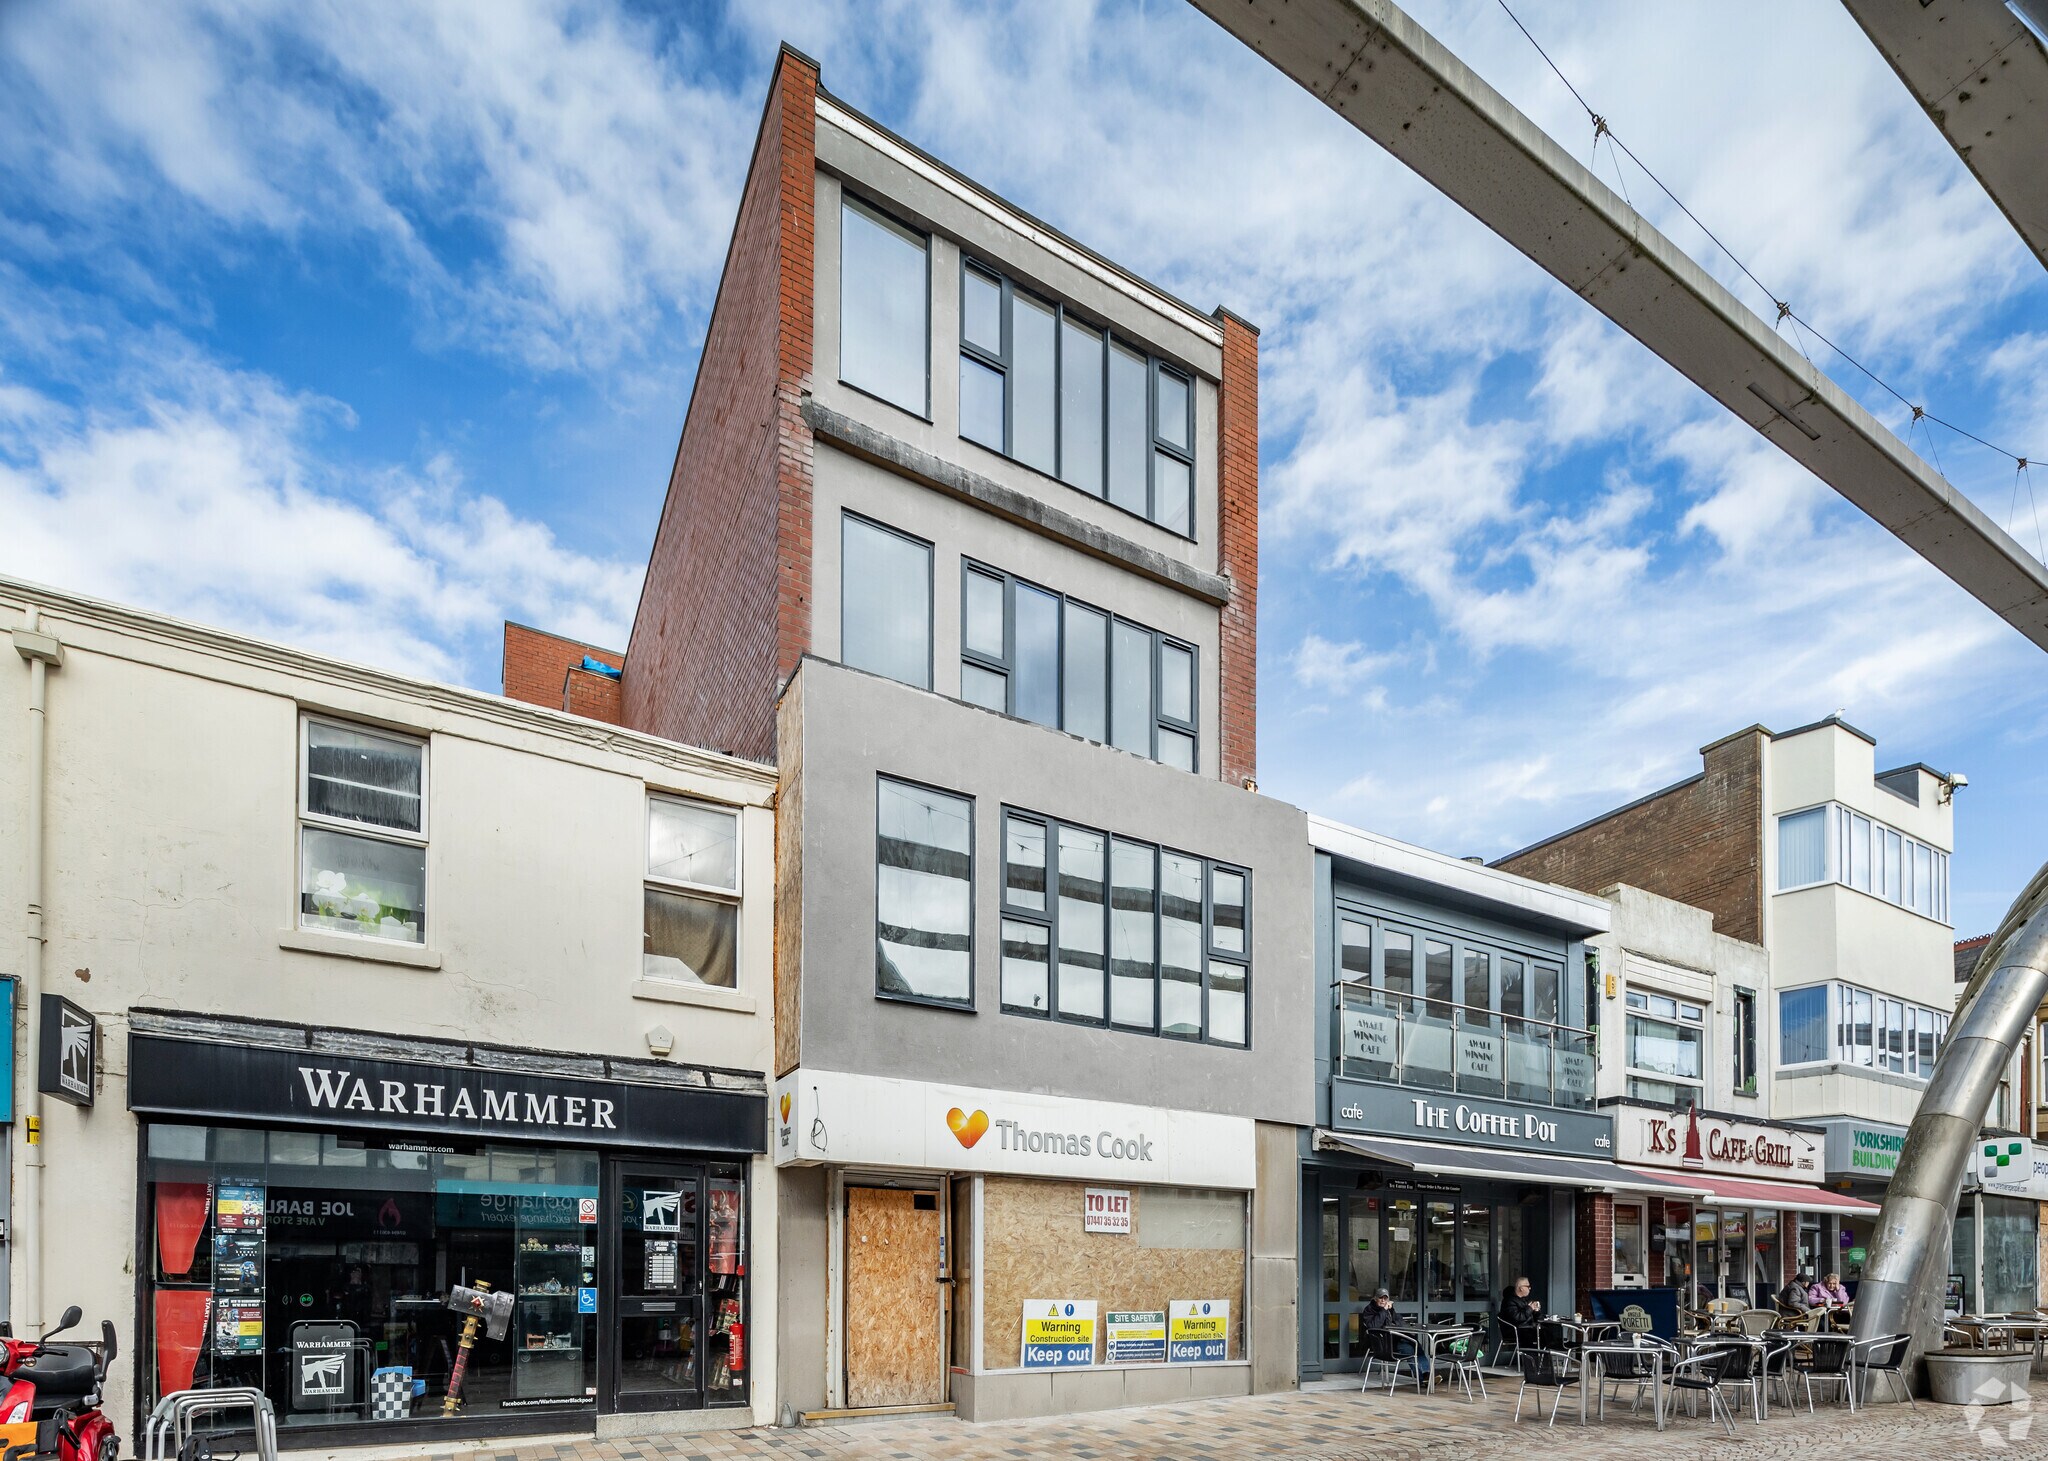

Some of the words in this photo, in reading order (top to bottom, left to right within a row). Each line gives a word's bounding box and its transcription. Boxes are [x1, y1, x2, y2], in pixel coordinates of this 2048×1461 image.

[1353, 1030, 1388, 1044] WINNING
[1361, 1044, 1382, 1055] CAFE
[1464, 1049, 1494, 1062] WINNING
[1471, 1062, 1489, 1073] CAFE
[61, 1074, 89, 1095] WARHAMMER
[298, 1067, 617, 1129] WARHAMMER
[1341, 1102, 1363, 1120] cafe
[1411, 1098, 1449, 1129] THE
[1455, 1104, 1520, 1138] COFFEE
[1524, 1113, 1558, 1142] POT
[995, 1118, 1091, 1157] Thomas
[1096, 1130, 1153, 1162] Cook
[1594, 1134, 1610, 1149] cafe
[388, 1142, 454, 1154] warhammer.com
[1706, 1127, 1747, 1162] CAFE
[1748, 1144, 1754, 1158] &
[1754, 1135, 1794, 1168] GRILL
[1087, 1194, 1104, 1212] TO
[1107, 1195, 1129, 1213] LET
[1087, 1215, 1103, 1226] 07447
[1104, 1216, 1112, 1226] 35
[1121, 1217, 1129, 1227] 35
[204, 1297, 212, 1320] START
[1114, 1314, 1129, 1323] SITE
[1130, 1313, 1156, 1322] SAFETY
[1622, 1317, 1650, 1329] PORETTI
[1041, 1321, 1081, 1335] Warning
[1183, 1320, 1216, 1332] Warning
[1030, 1334, 1075, 1343] Construction
[1077, 1335, 1090, 1343] site
[1174, 1331, 1212, 1340] Construction
[296, 1341, 351, 1349] WARHAMMER
[1172, 1343, 1202, 1360] Keep
[1205, 1342, 1224, 1356] out
[1027, 1346, 1062, 1365] Keep
[1067, 1347, 1090, 1362] out
[502, 1397, 594, 1407] Facebook.com/WarhammerBlackpool
